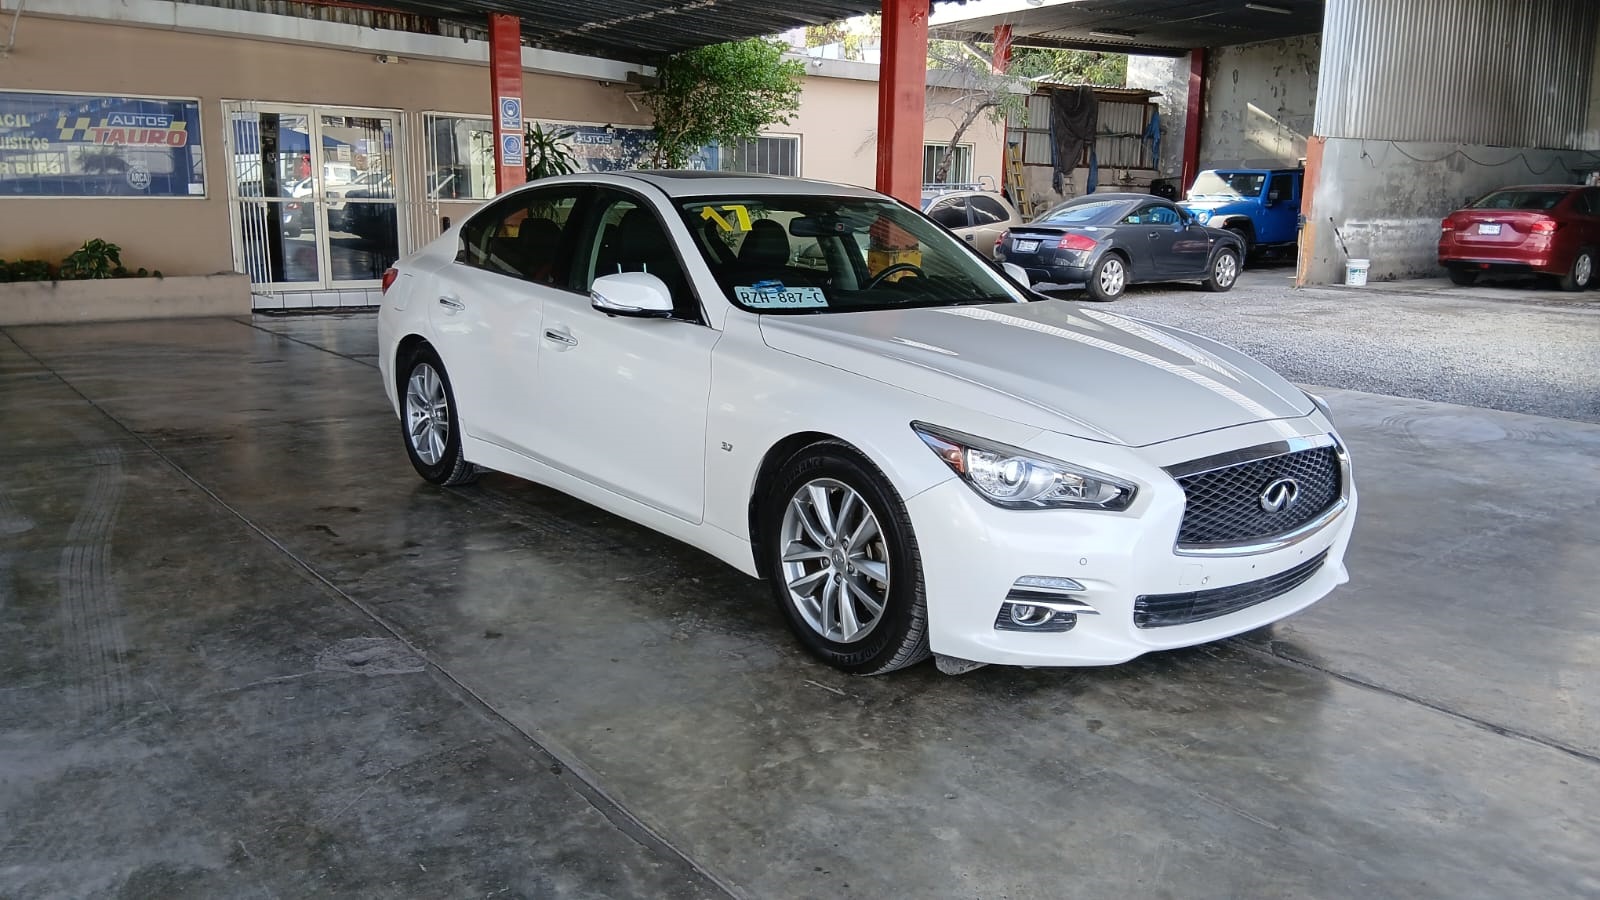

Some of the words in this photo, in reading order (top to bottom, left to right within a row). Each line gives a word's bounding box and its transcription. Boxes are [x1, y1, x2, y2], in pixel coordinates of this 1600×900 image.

[111, 115, 168, 127] AUTOS
[91, 127, 187, 147] TAURO
[700, 205, 752, 231] 17
[740, 292, 825, 303] RZH-887-C
